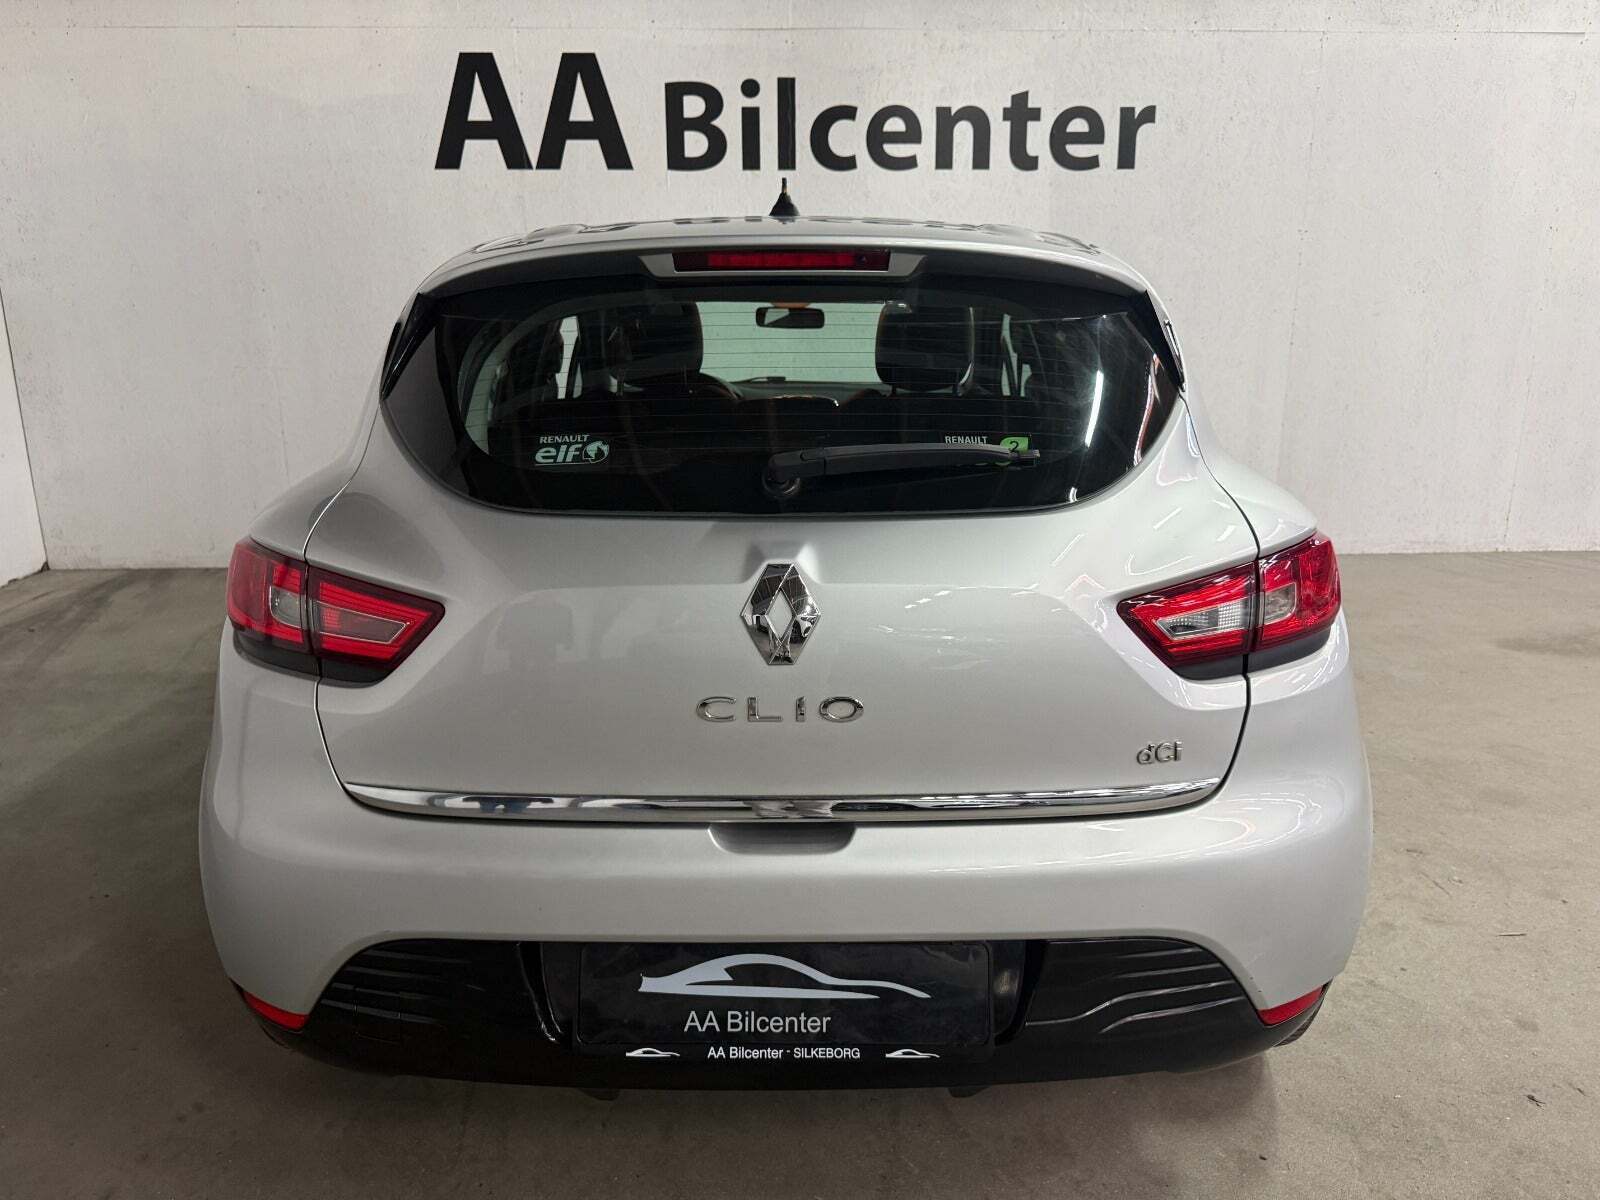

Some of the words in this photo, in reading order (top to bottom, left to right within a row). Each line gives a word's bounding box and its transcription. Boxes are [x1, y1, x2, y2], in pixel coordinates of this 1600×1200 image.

[435, 52, 633, 171] AA
[665, 77, 1156, 172] Bilcenter
[539, 435, 590, 444] RENAULT
[945, 435, 988, 445] RENAULT
[535, 444, 582, 463] elf
[696, 696, 865, 723] CLIO
[684, 1010, 720, 1033] AA
[728, 1010, 831, 1033] Bilcenter
[708, 1047, 725, 1060] AA
[730, 1047, 783, 1059] Bilcenter
[794, 1047, 860, 1059] SILKEBORG
